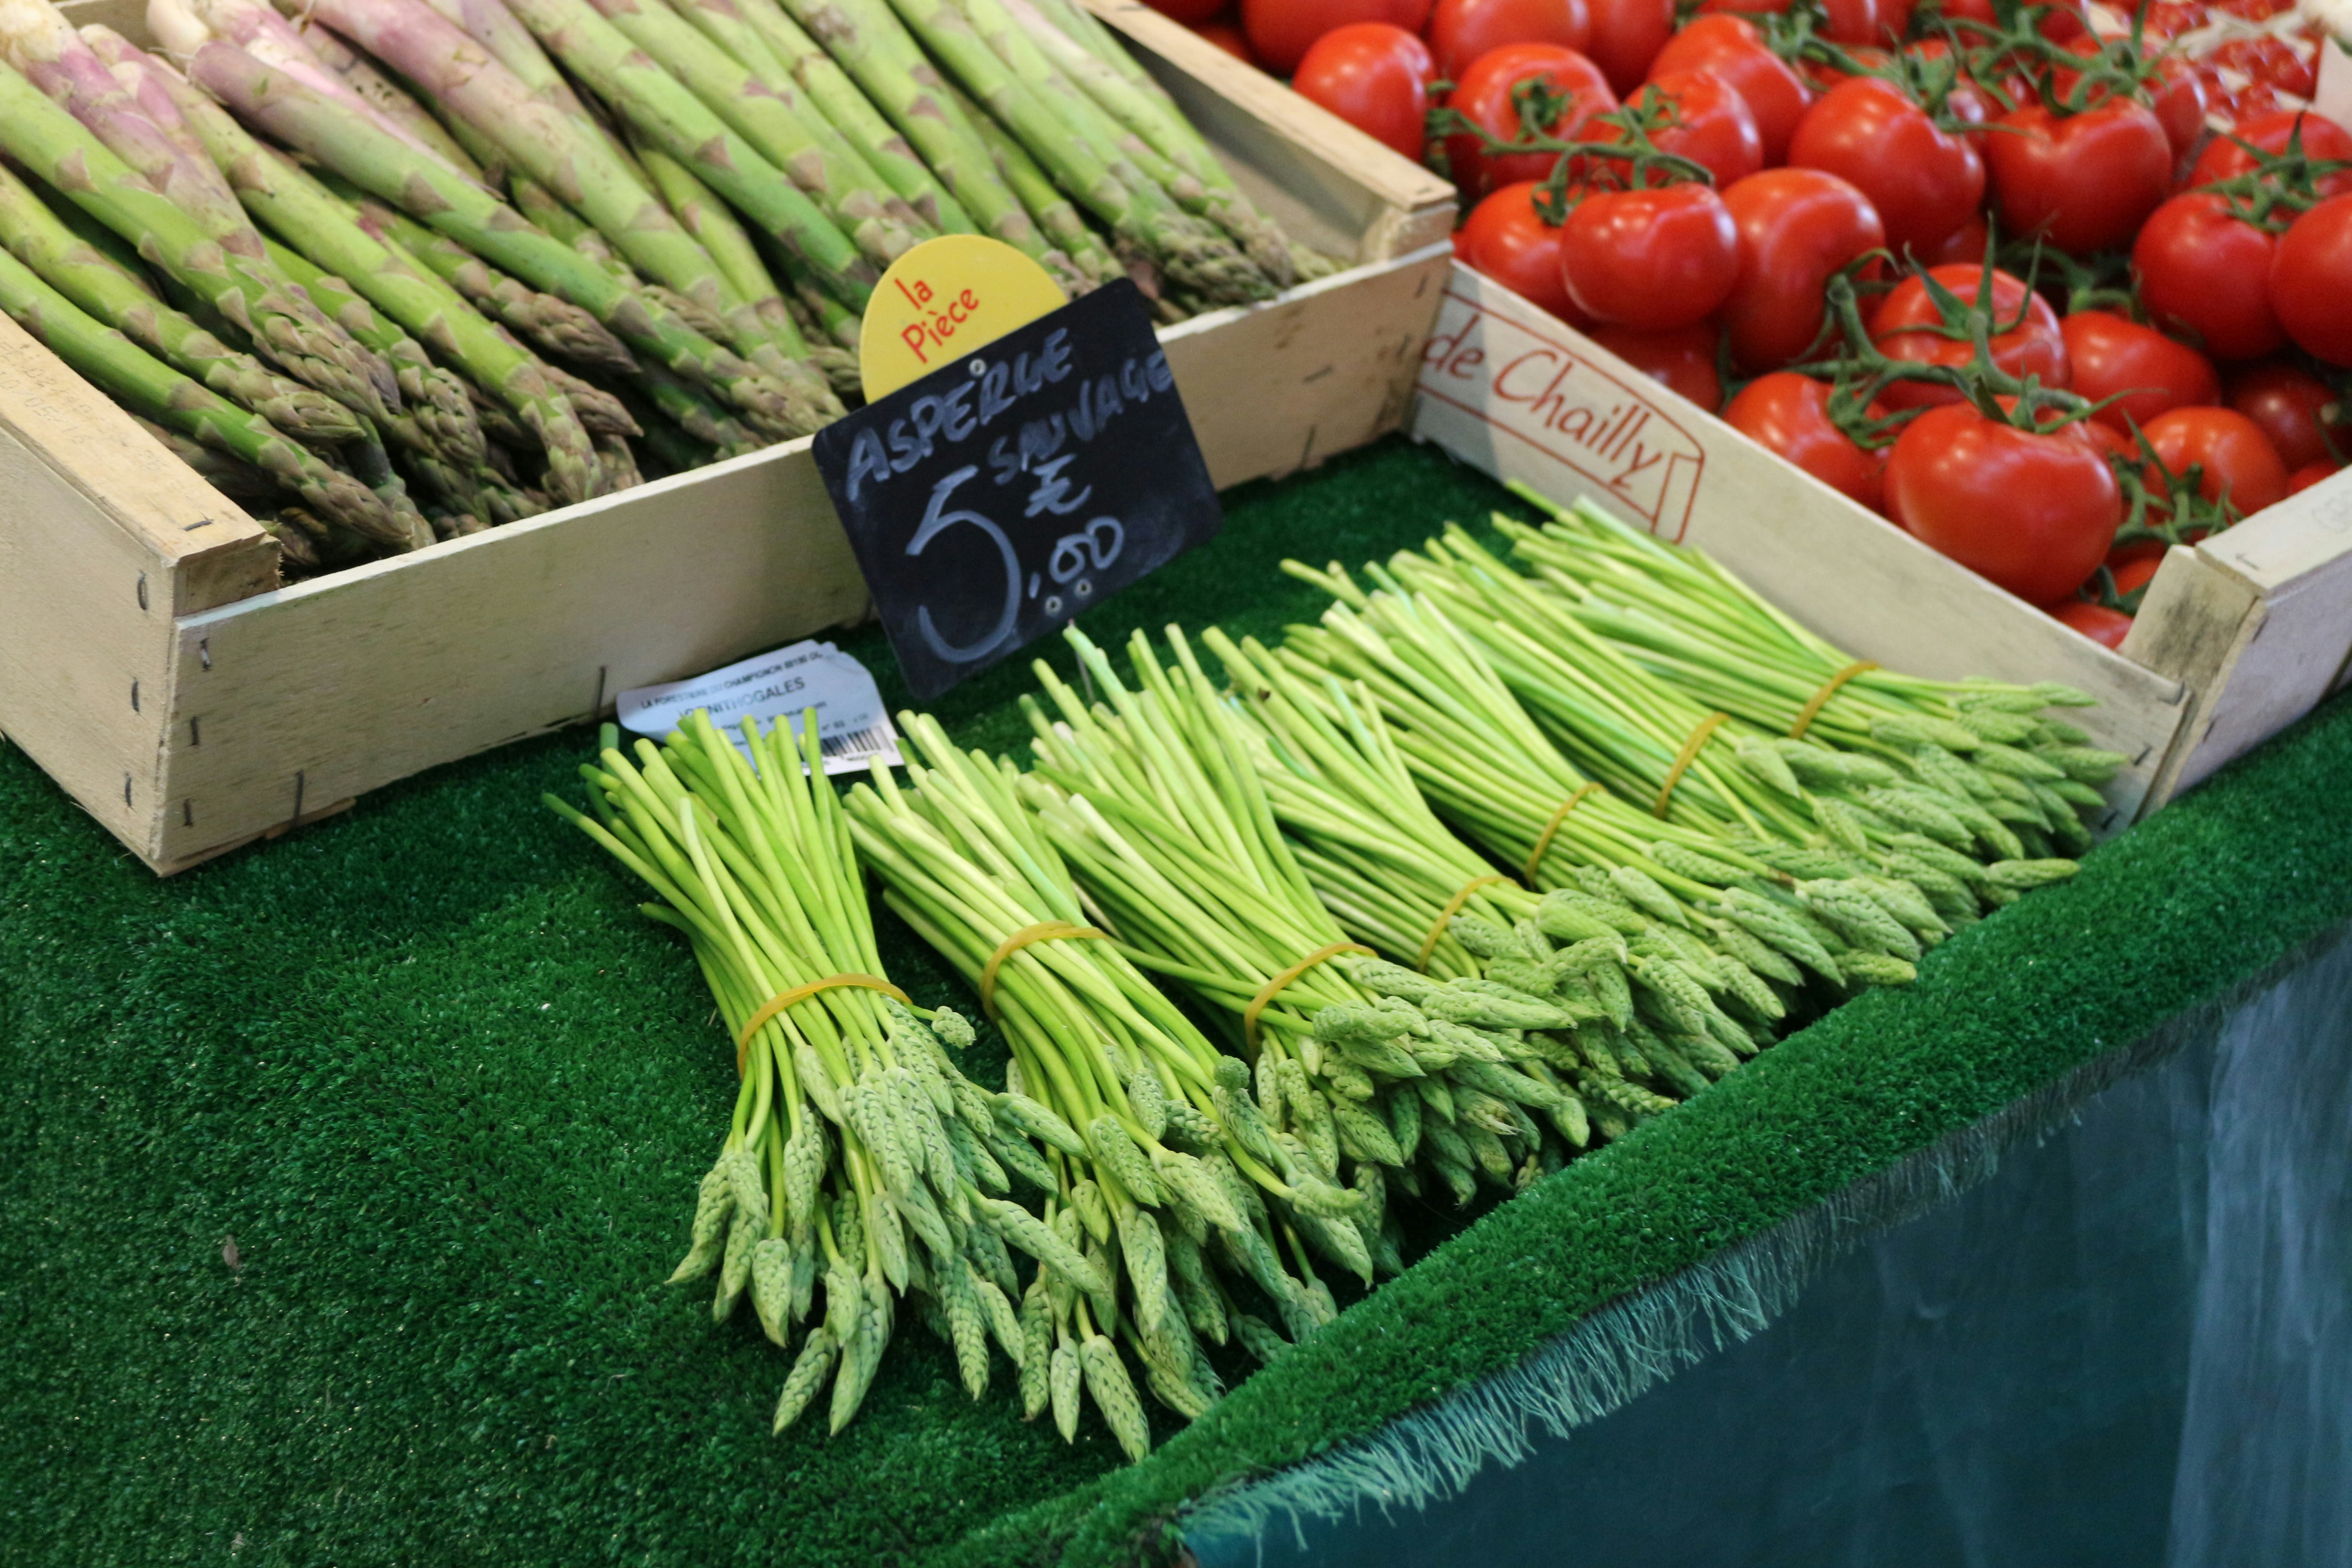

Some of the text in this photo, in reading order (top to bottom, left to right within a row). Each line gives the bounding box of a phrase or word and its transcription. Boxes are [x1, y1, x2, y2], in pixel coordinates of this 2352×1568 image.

[893, 278, 934, 310] la
[901, 288, 980, 364] Pièce
[1420, 314, 1663, 490] de Chailly
